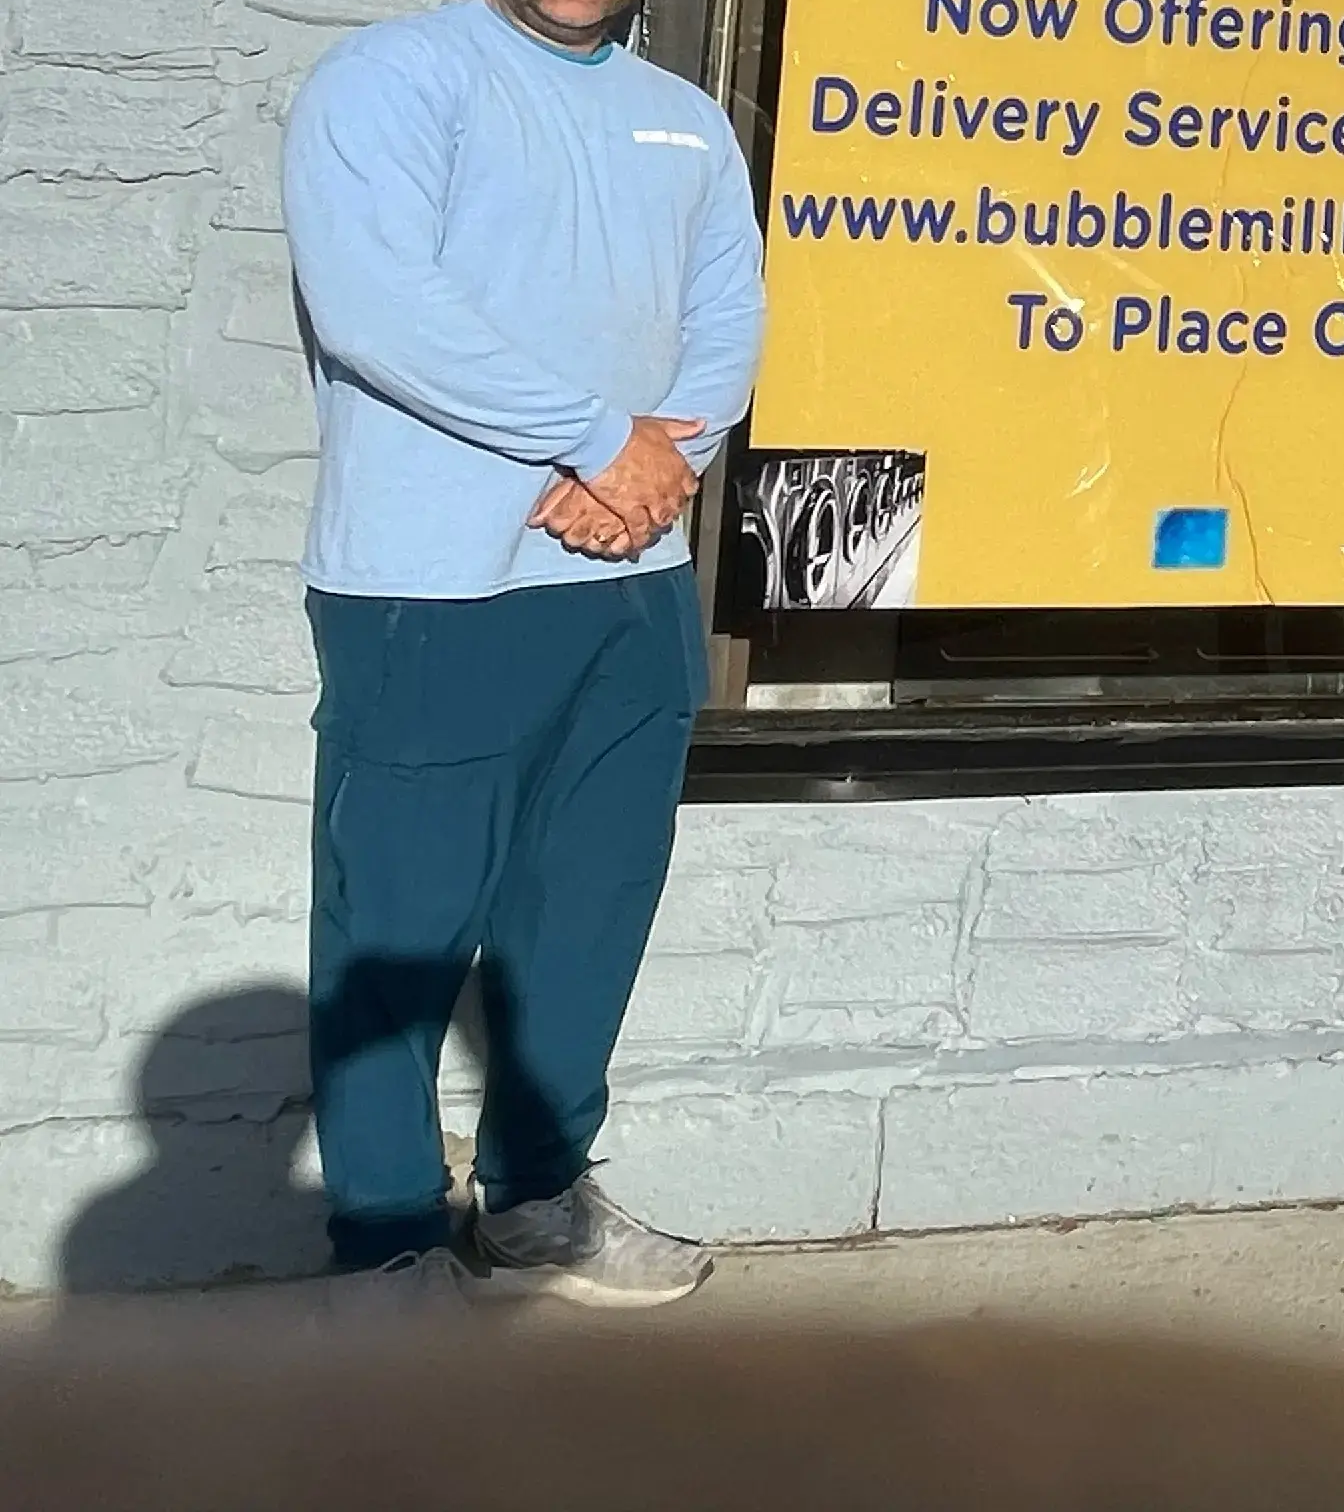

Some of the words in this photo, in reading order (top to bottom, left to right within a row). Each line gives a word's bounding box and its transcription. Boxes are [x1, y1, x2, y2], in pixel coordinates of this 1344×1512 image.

[811, 77, 1099, 155] Delivery
[1009, 294, 1082, 350] To
[1113, 296, 1287, 356] Place
